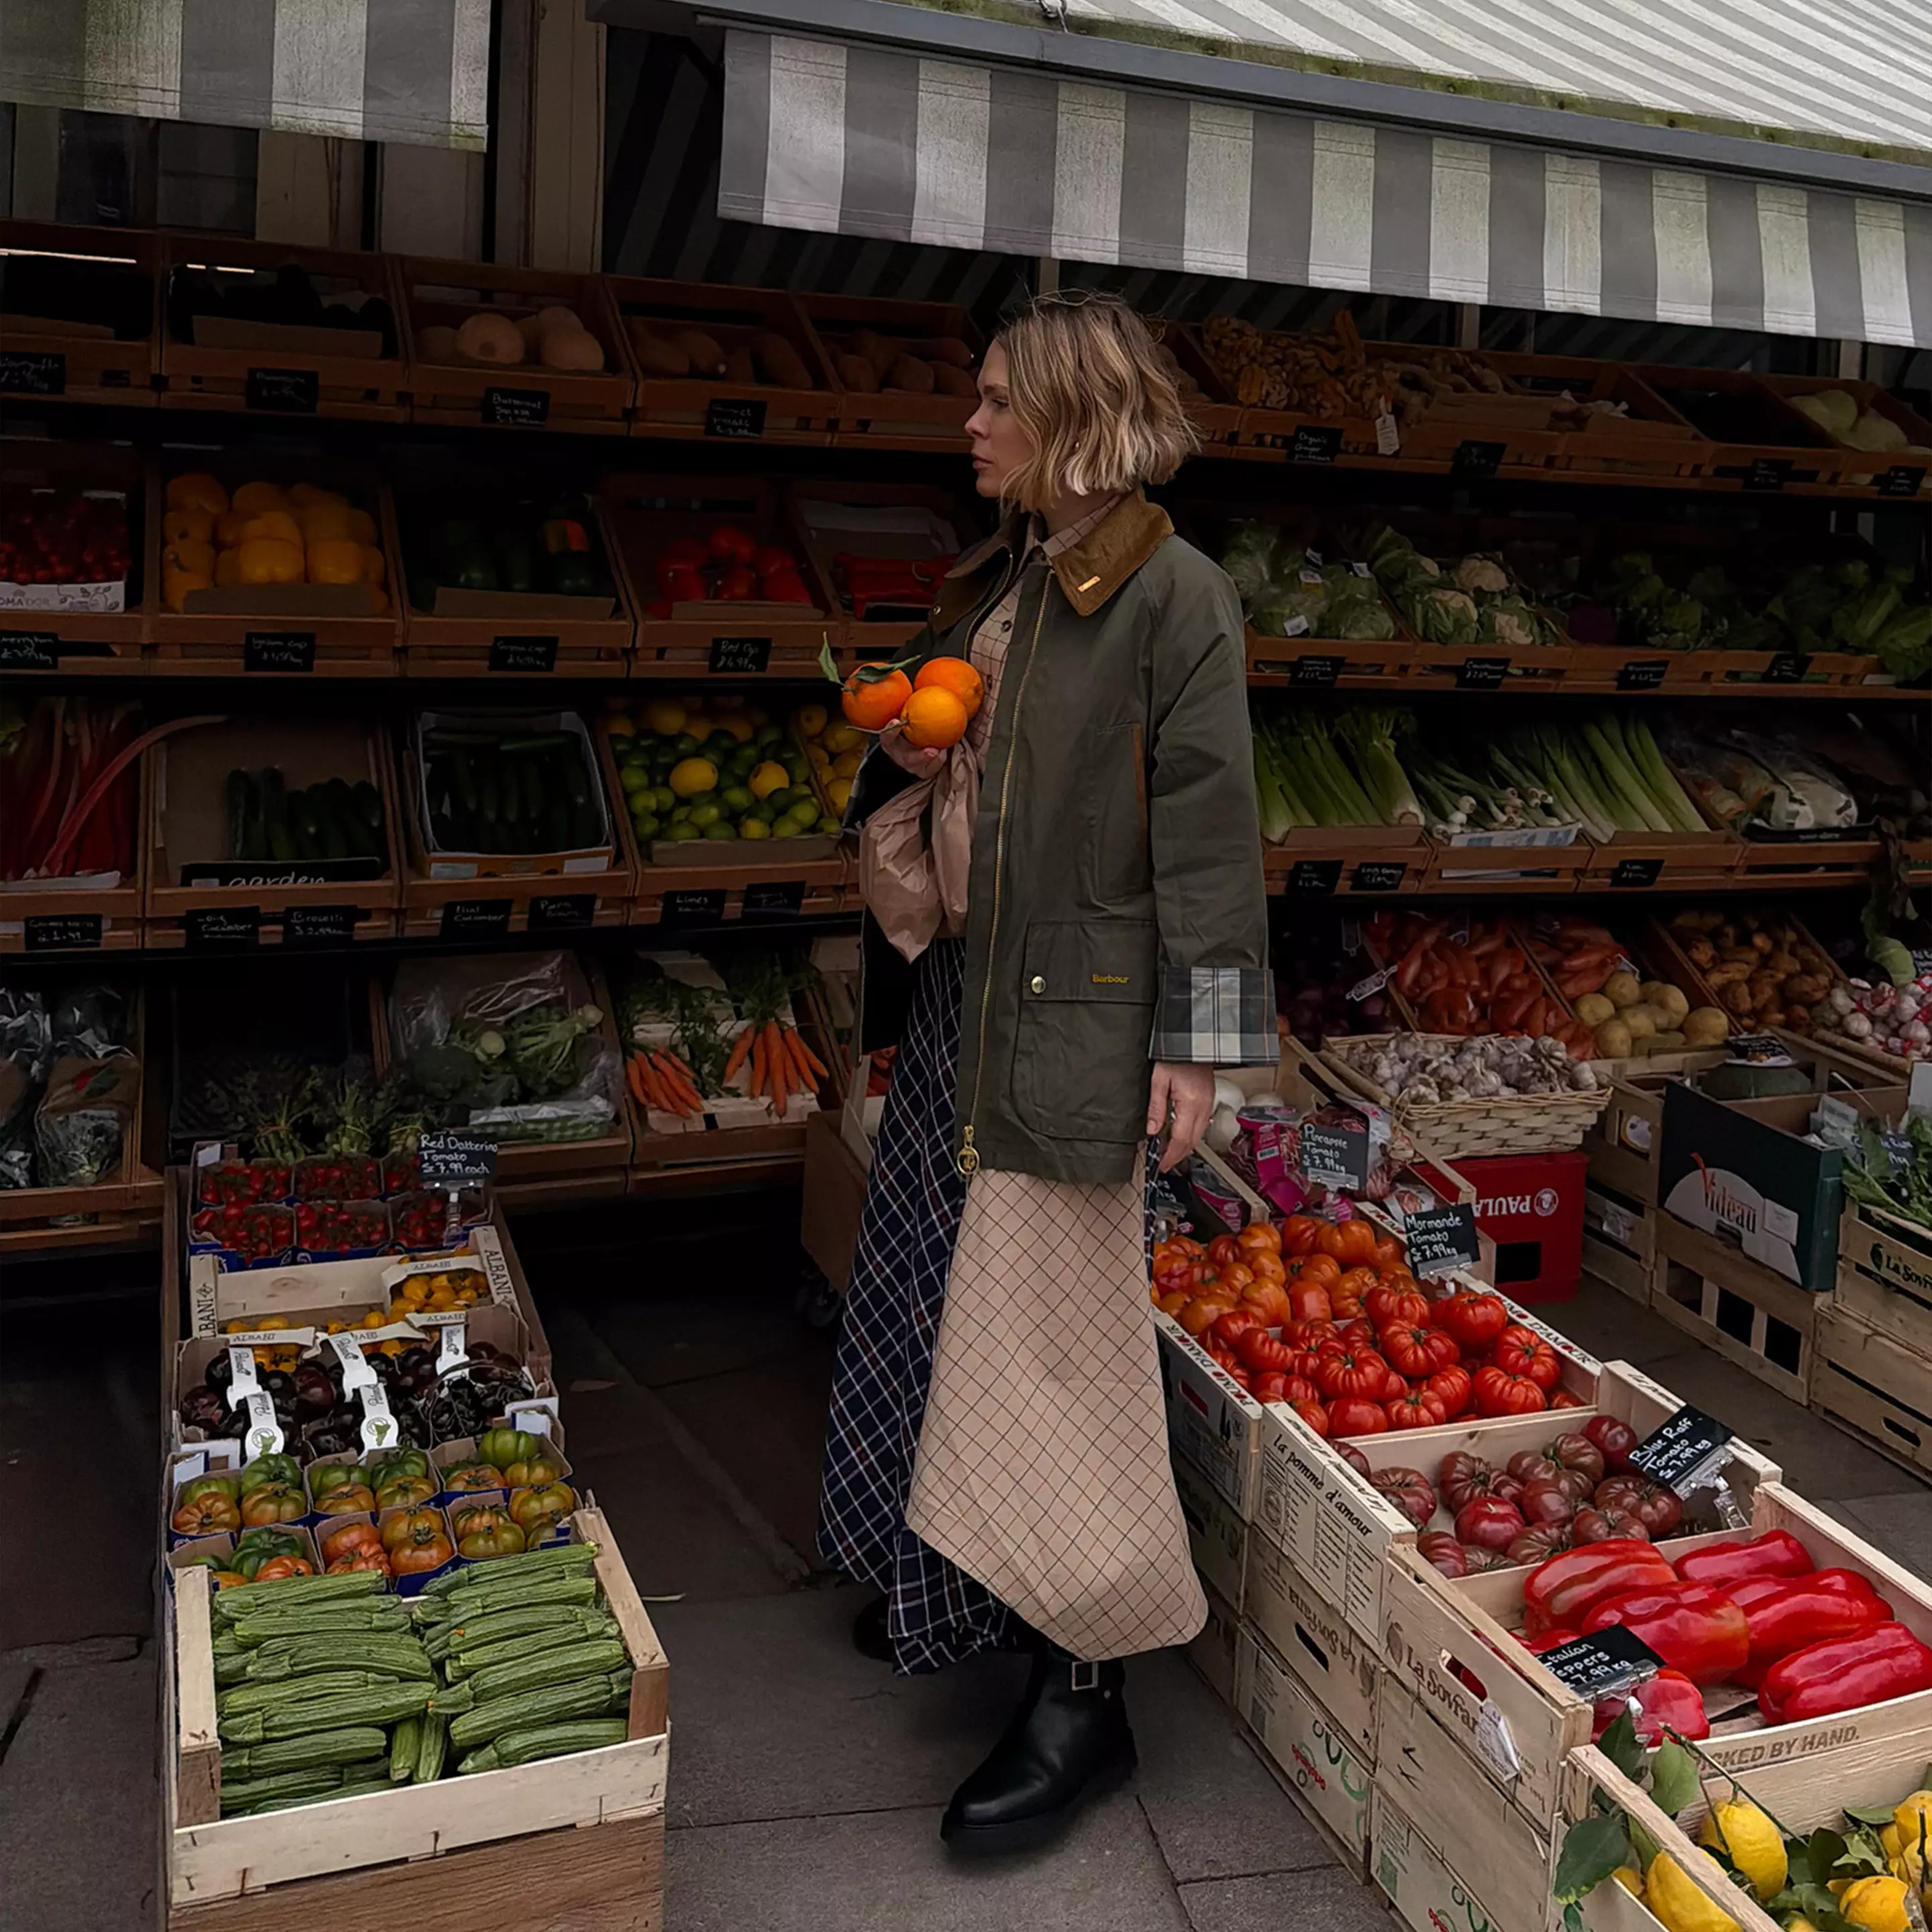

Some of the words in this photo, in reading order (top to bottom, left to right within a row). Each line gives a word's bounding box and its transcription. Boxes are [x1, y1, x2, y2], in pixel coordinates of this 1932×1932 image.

[1091, 974, 1130, 983] Barbour
[419, 1149, 468, 1162] Tomato
[420, 1133, 444, 1149] Red
[1690, 1151, 1757, 1234] Videau
[1405, 1211, 1464, 1231] Mormande
[1407, 1230, 1450, 1244] Tomato
[483, 1249, 512, 1296] ALBANI
[1886, 1254, 1901, 1276] La
[196, 1297, 217, 1339] LBANI
[1628, 1438, 1668, 1466] Blue
[1662, 1416, 1694, 1440] Raff
[1643, 1438, 1690, 1472] Tomato
[1273, 1434, 1289, 1455] la
[1285, 1451, 1325, 1491] pomme
[1324, 1489, 1373, 1537] d'amour
[1407, 1644, 1425, 1680] La
[1546, 1651, 1610, 1677] Peppers
[1768, 1737, 1799, 1759] BY
[1801, 1725, 1860, 1752] HAND.
